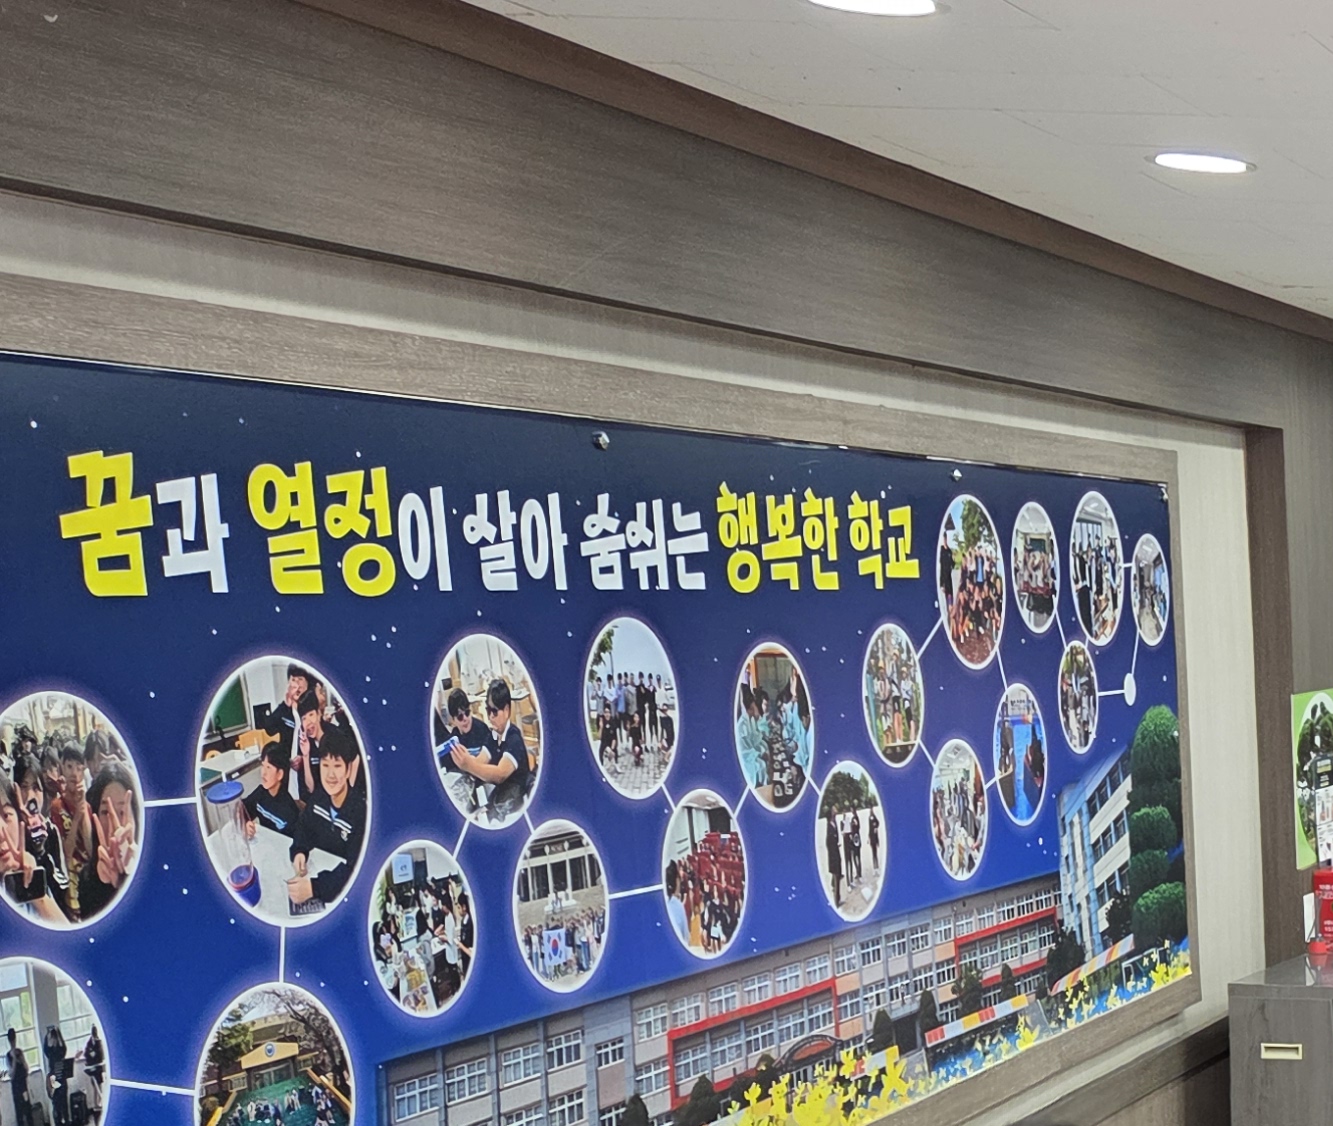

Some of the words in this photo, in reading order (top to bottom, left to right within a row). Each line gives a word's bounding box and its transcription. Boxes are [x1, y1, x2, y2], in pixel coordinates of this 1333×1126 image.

[61, 450, 228, 596] 꿈과
[248, 461, 452, 596] 열정이
[462, 487, 567, 591] 살아
[580, 492, 709, 591] 숨쉬는
[716, 480, 839, 594] 행복한
[848, 489, 920, 590] 학교
